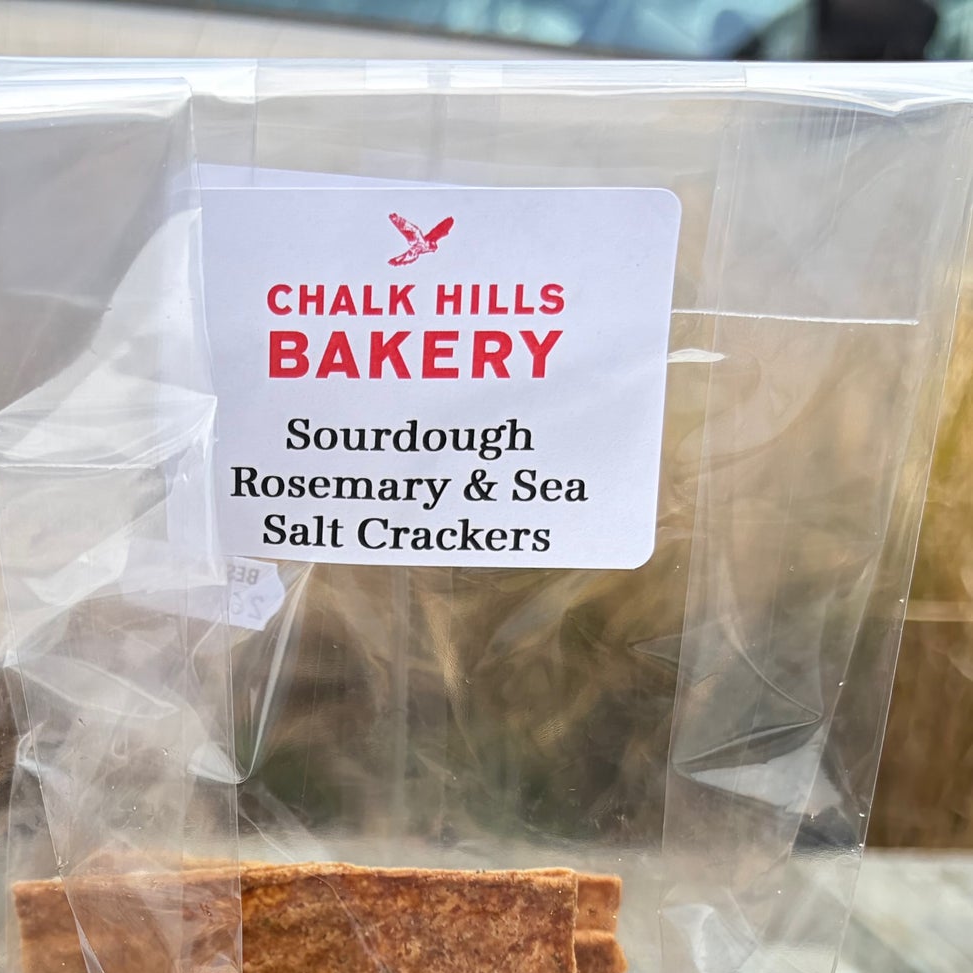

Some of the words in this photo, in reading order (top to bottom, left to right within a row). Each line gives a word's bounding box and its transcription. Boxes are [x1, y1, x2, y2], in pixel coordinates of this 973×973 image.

[267, 284, 415, 316] CHALK
[436, 284, 565, 316] HILLS
[268, 330, 564, 379] BAKERY
[285, 418, 535, 460] Sourdough
[230, 466, 451, 510] Rosemary
[463, 469, 499, 502] &
[511, 469, 589, 502] Sea
[261, 514, 344, 548] Salt
[357, 517, 551, 552] Crackers
